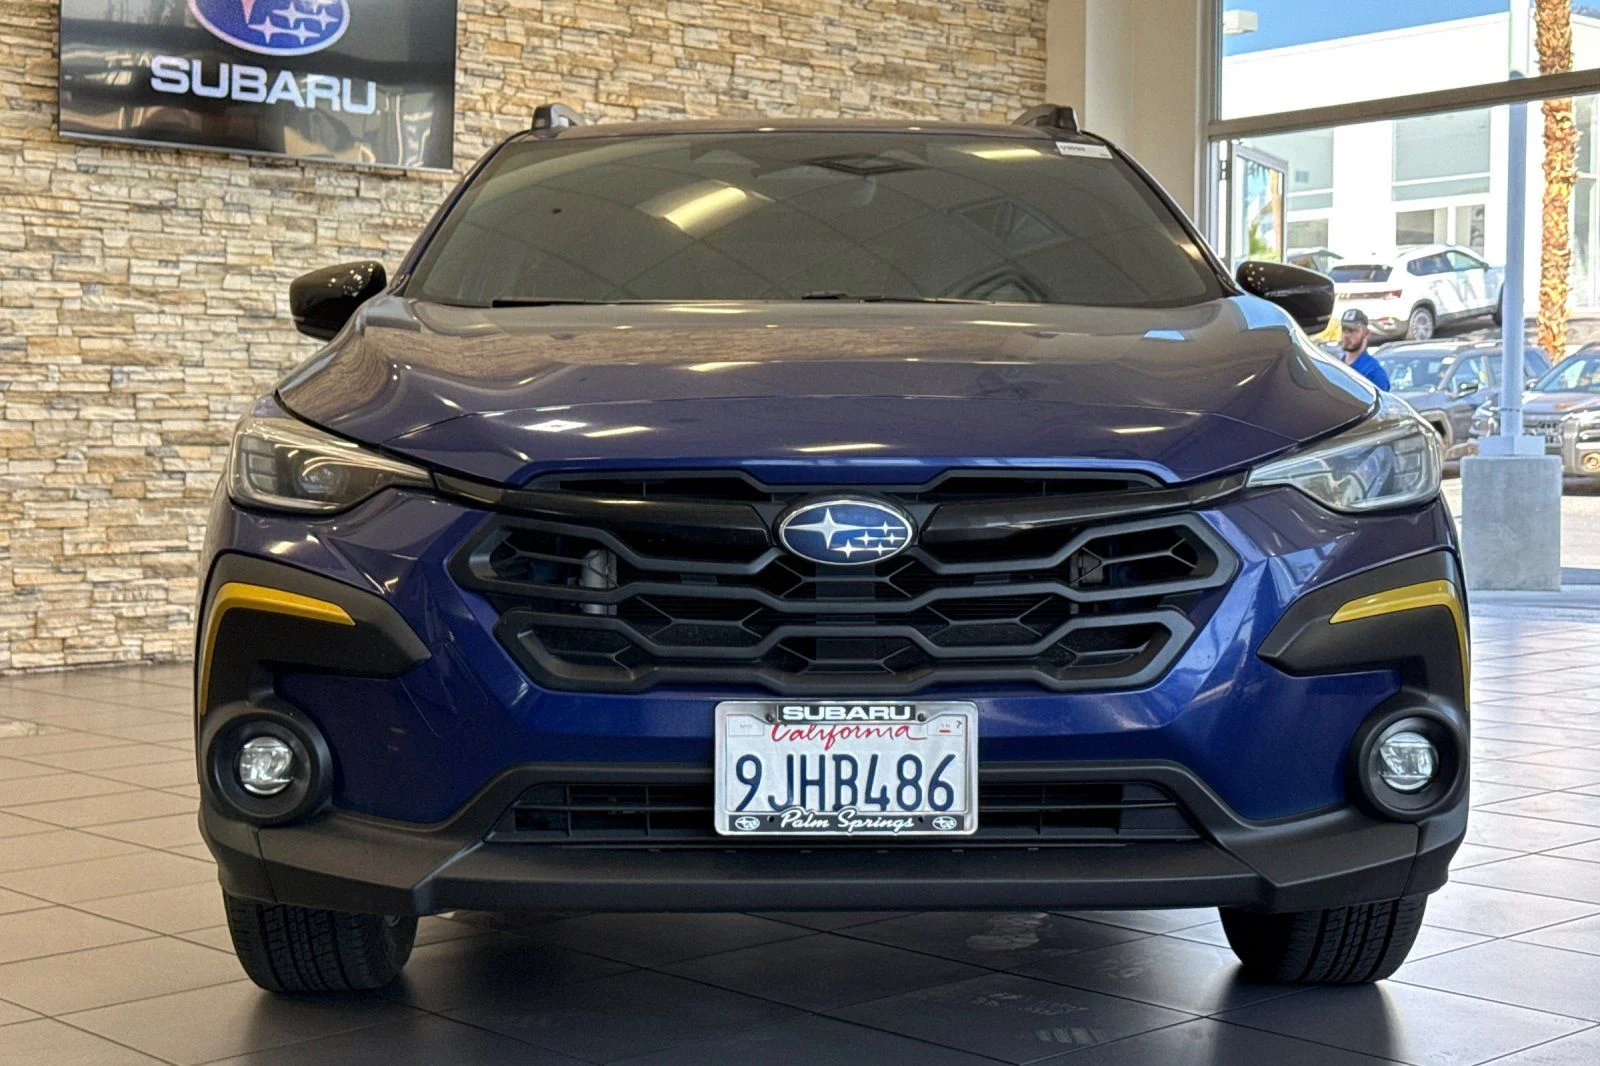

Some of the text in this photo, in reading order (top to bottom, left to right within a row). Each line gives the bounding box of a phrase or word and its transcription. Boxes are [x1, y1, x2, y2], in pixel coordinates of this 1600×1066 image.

[150, 55, 376, 115] SUBARU
[782, 706, 911, 720] SUBARU
[771, 723, 928, 751] California
[735, 754, 957, 812] 9JHB486
[781, 809, 915, 833] Palm Springs
